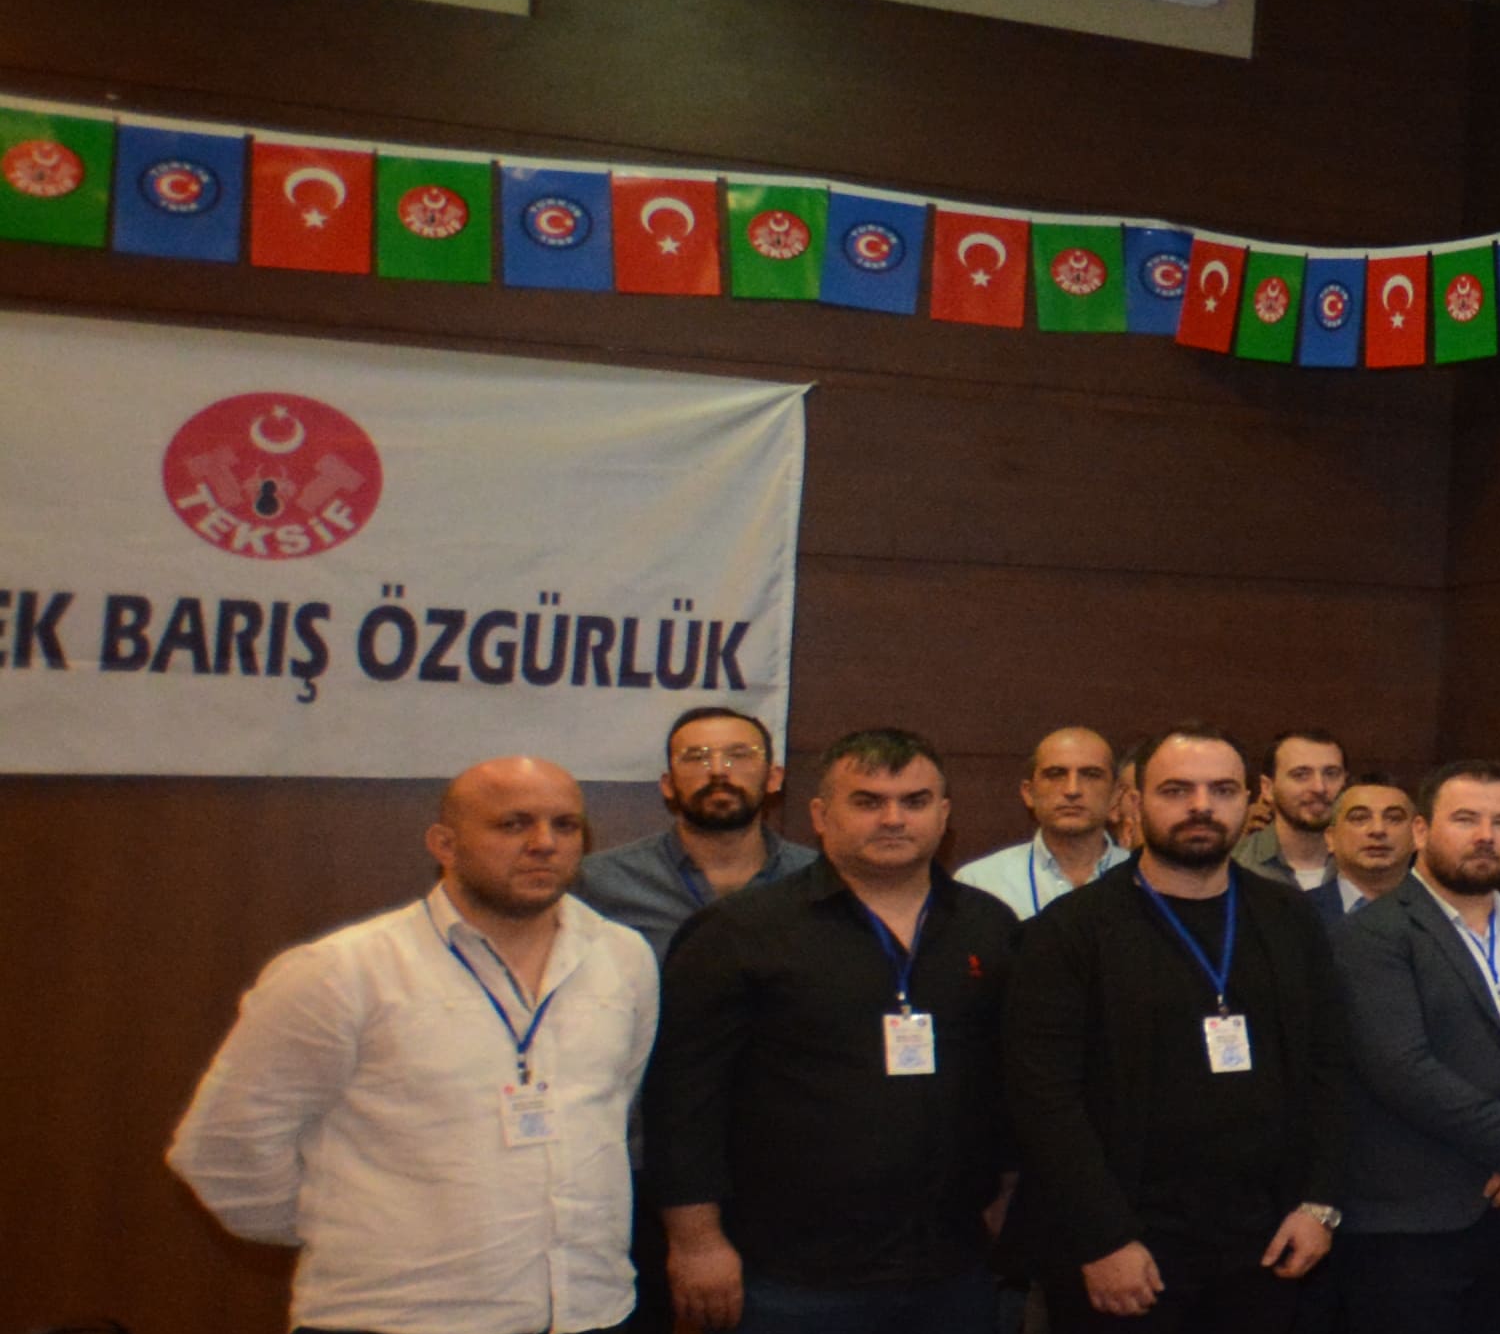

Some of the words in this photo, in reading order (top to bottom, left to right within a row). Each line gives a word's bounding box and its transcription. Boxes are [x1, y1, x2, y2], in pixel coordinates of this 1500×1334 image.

[176, 483, 355, 555] TEKSİF
[101, 595, 331, 703] BARIŞ
[357, 583, 751, 690] ÖZGÜRLÜK
